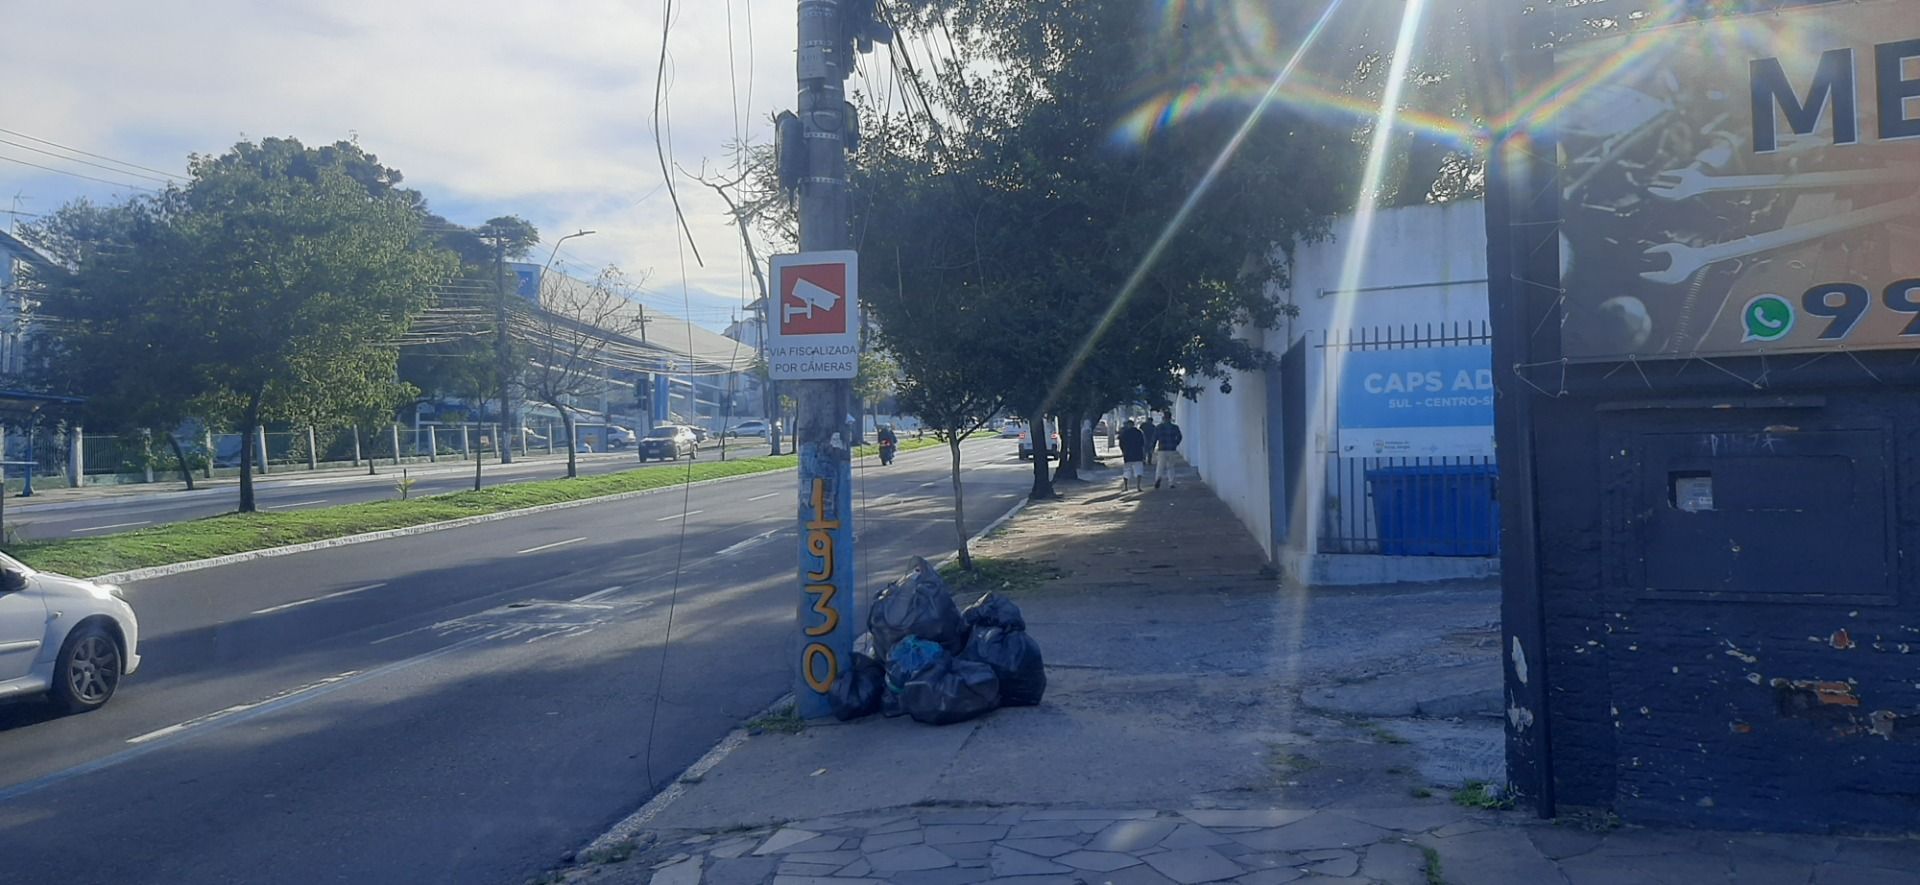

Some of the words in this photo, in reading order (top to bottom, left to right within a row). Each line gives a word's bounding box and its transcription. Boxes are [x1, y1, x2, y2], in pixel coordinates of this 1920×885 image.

[1749, 38, 1920, 154] ME
[769, 346, 787, 357] VIA
[789, 345, 857, 356] FISCALIZADA
[775, 363, 798, 373] POR
[800, 360, 853, 373] CÂMERAS
[1364, 370, 1443, 395] CAPS
[1388, 398, 1413, 409] SUL
[802, 478, 841, 694] 1930
